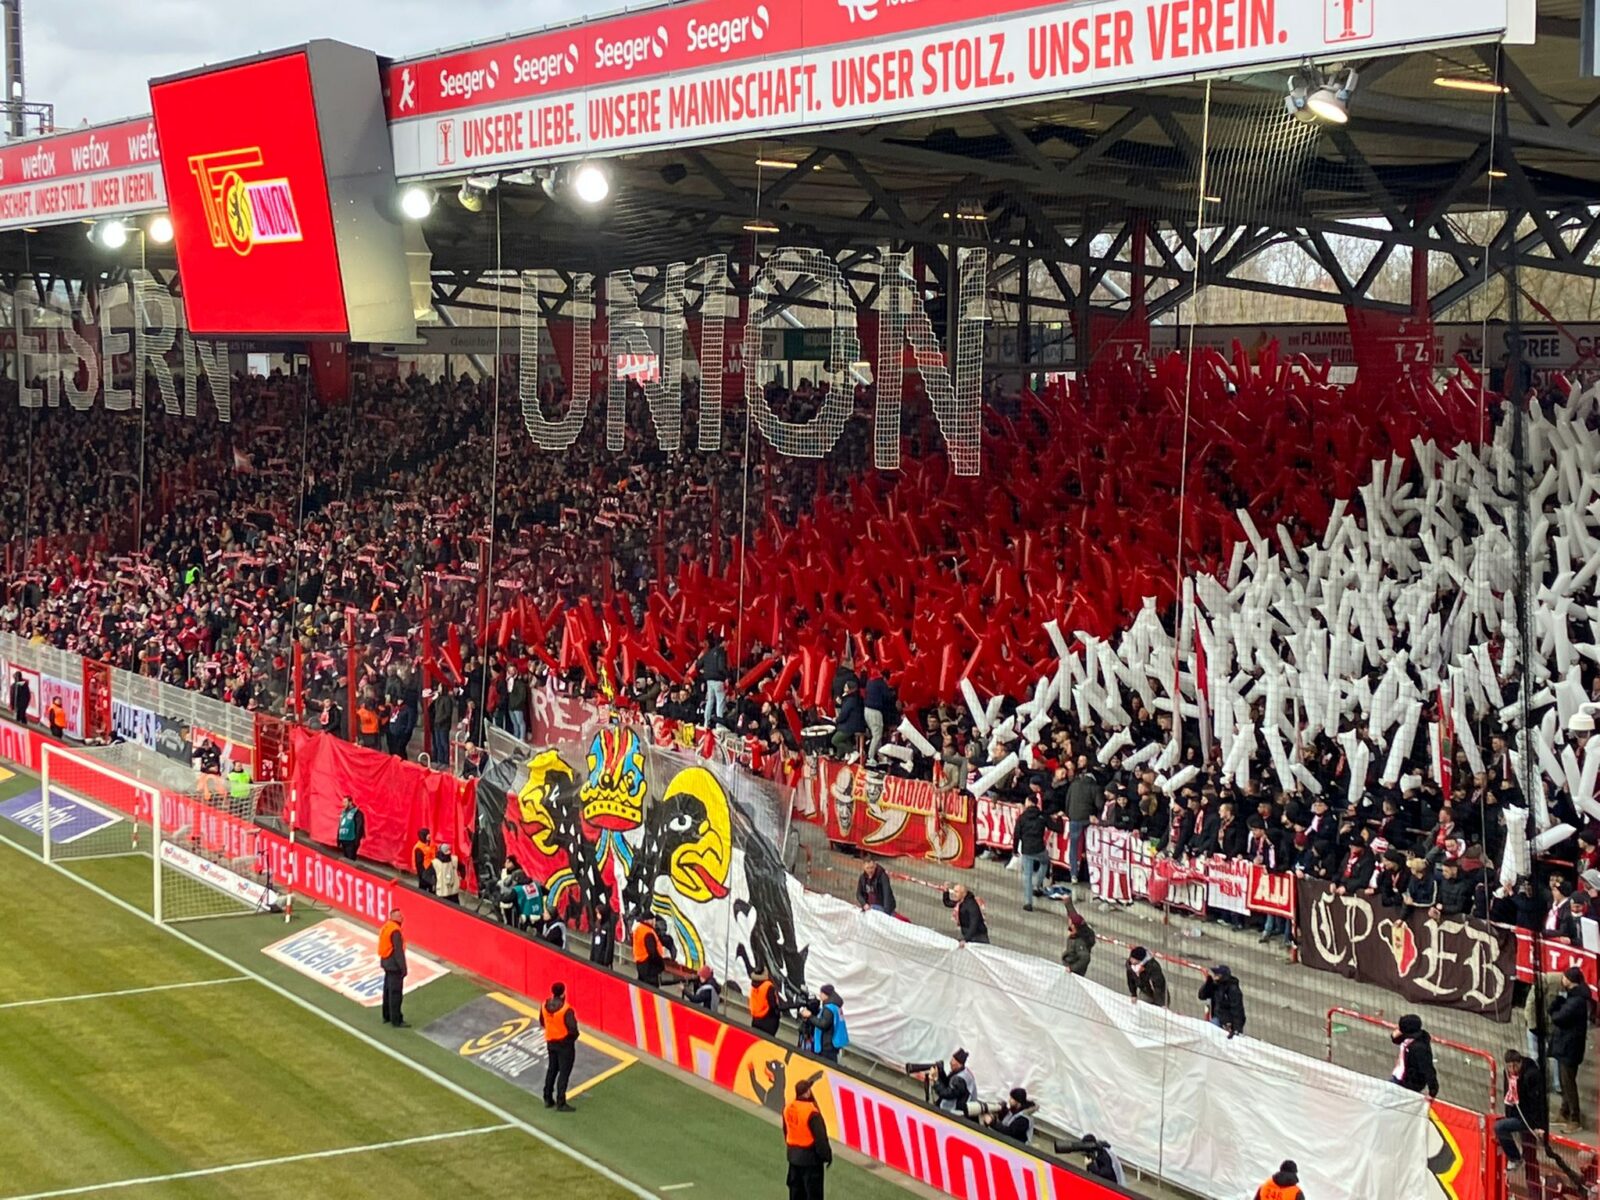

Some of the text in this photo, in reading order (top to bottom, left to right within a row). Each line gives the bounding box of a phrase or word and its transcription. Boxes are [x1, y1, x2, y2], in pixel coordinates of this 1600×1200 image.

[595, 37, 650, 70] Seeger
[687, 19, 749, 53] Seeger
[440, 69, 485, 99] Seeger
[463, 0, 1287, 158] UNSERE LIEBE. UNSERE MANNSCHAFT. UNSER STOLZ. UNSER VEREIN.
[513, 54, 563, 85] Seeger
[21, 145, 56, 179] wefox
[71, 135, 110, 171] wefox
[35, 187, 60, 215] UNSER
[61, 183, 87, 211] STOLZ.
[91, 177, 119, 207] UNSER
[122, 172, 157, 203] VEREIN.
[248, 185, 298, 236] UNION
[520, 247, 988, 476] UNION
[306, 852, 392, 922] FÖRSTEREI
